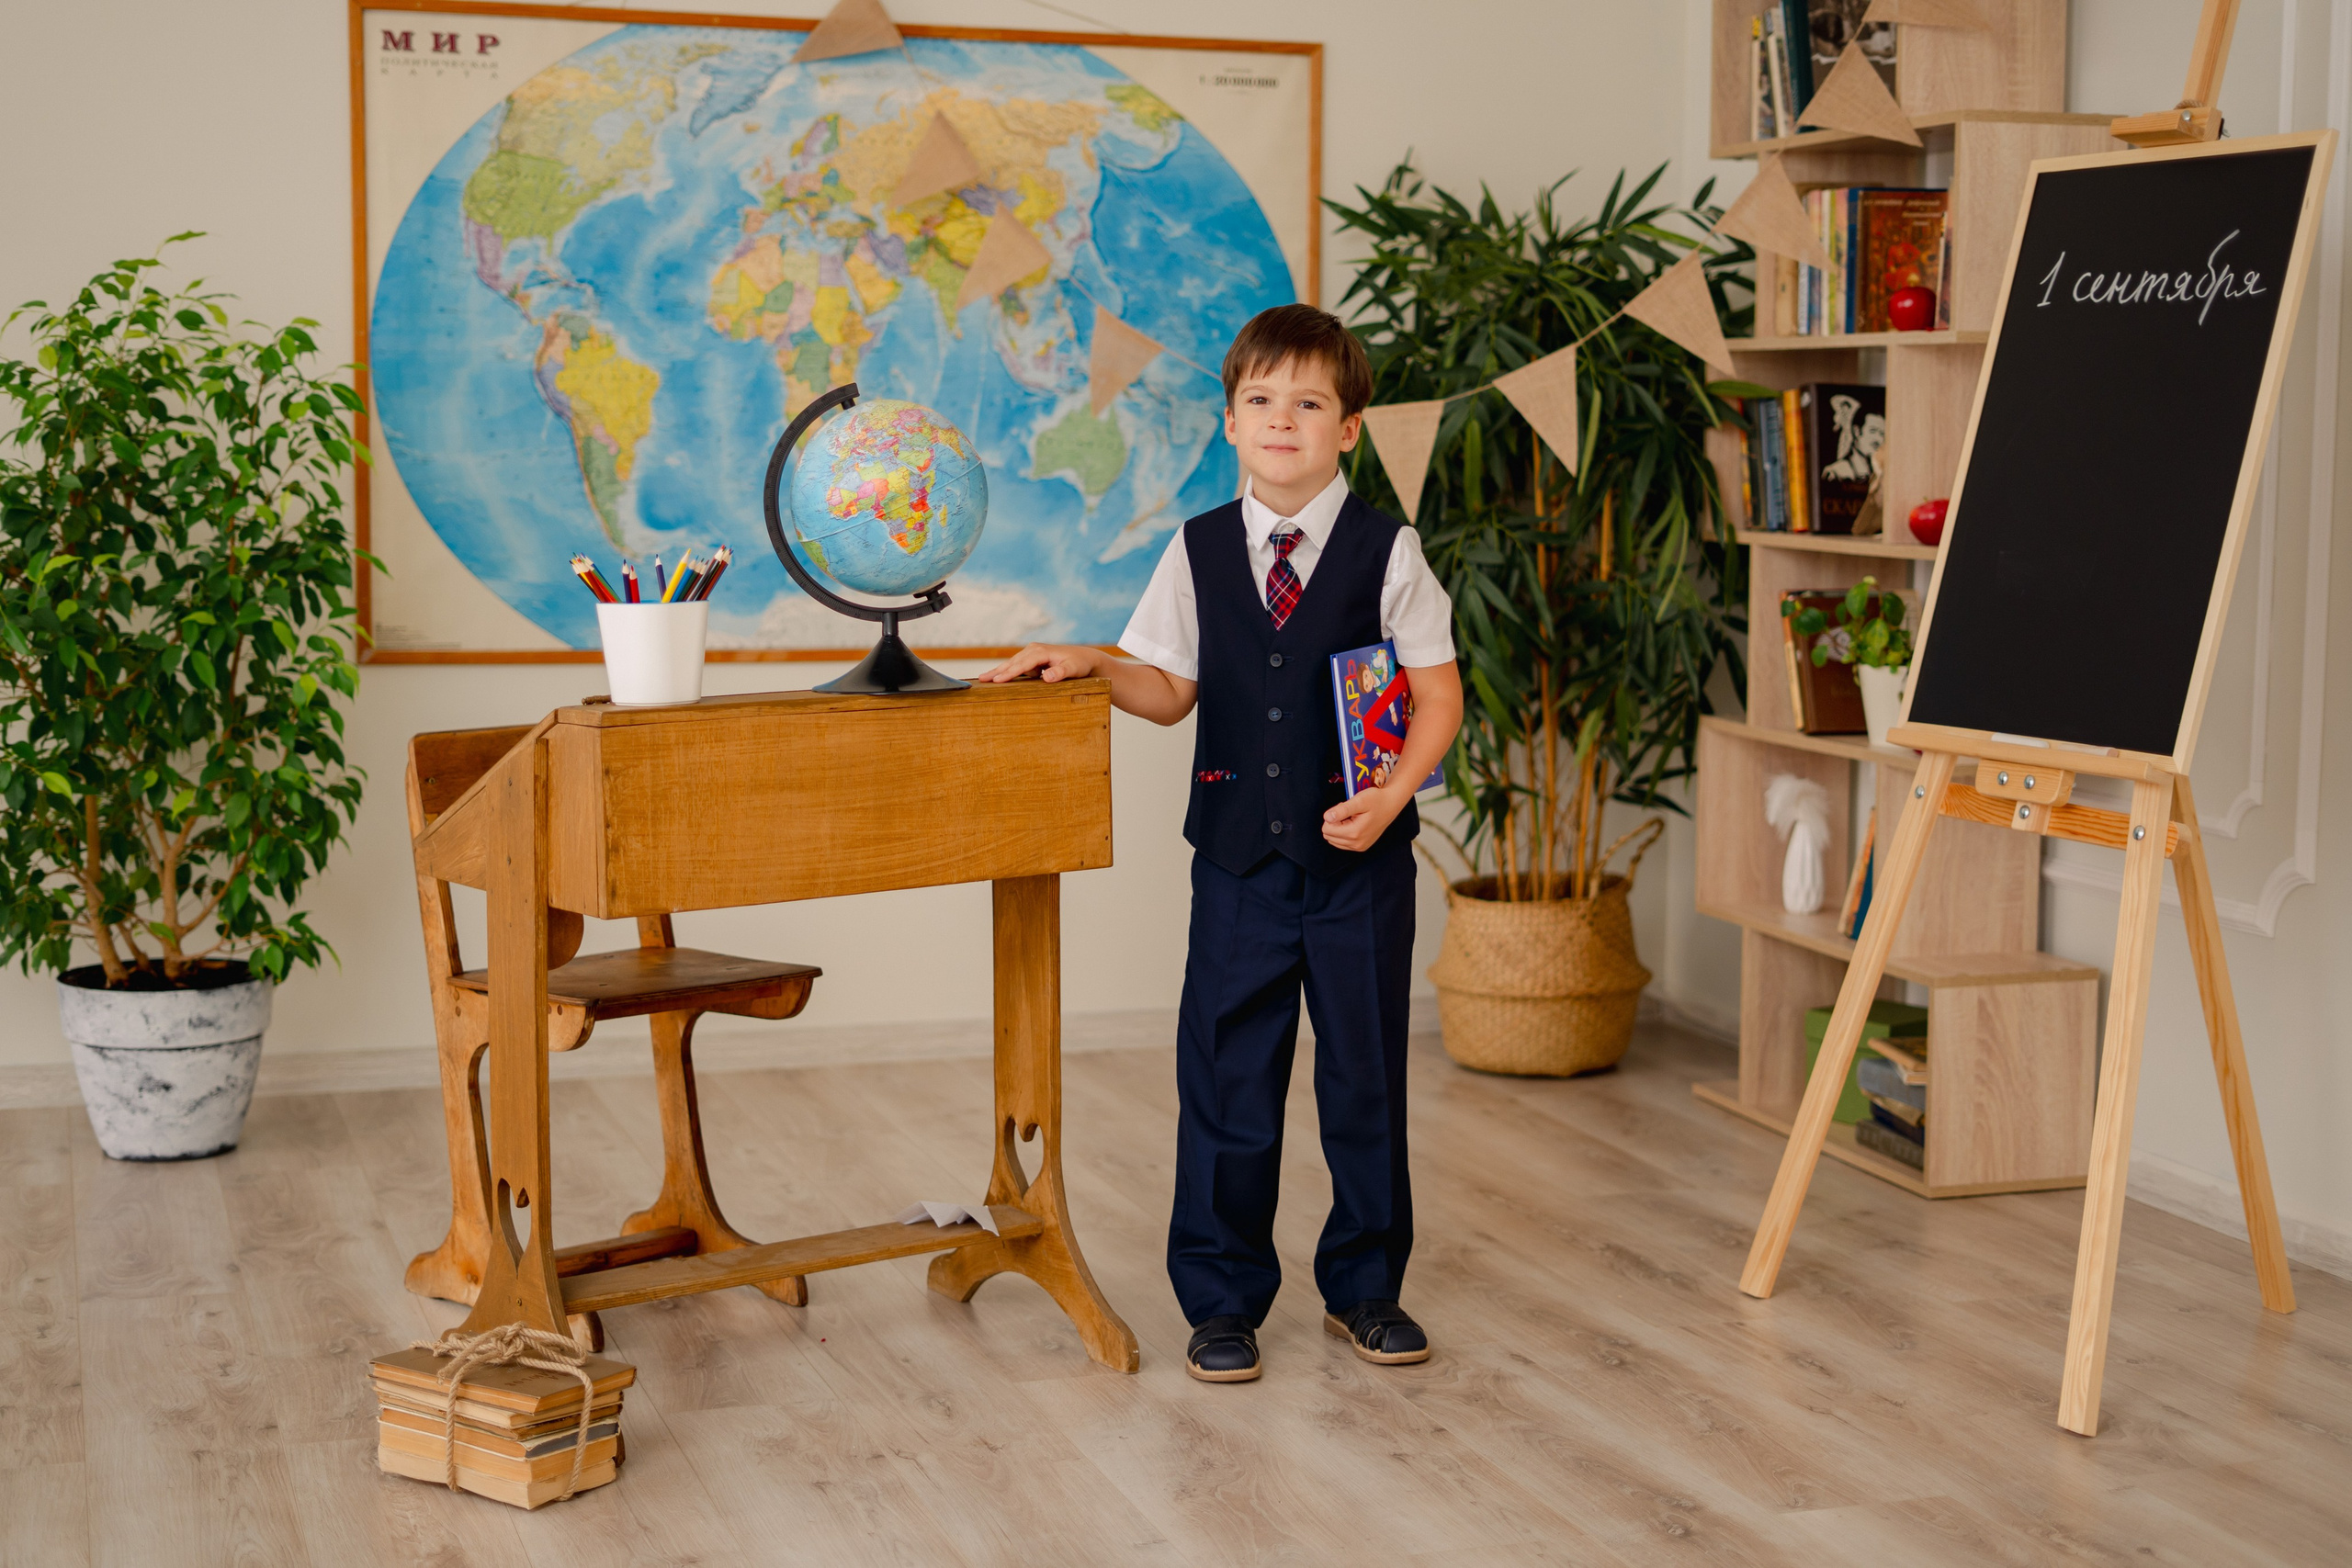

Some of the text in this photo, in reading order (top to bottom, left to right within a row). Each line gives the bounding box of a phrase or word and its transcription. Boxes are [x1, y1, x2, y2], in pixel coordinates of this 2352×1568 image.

[380, 29, 500, 55] МИР
[2036, 229, 2267, 326] 1 сентября
